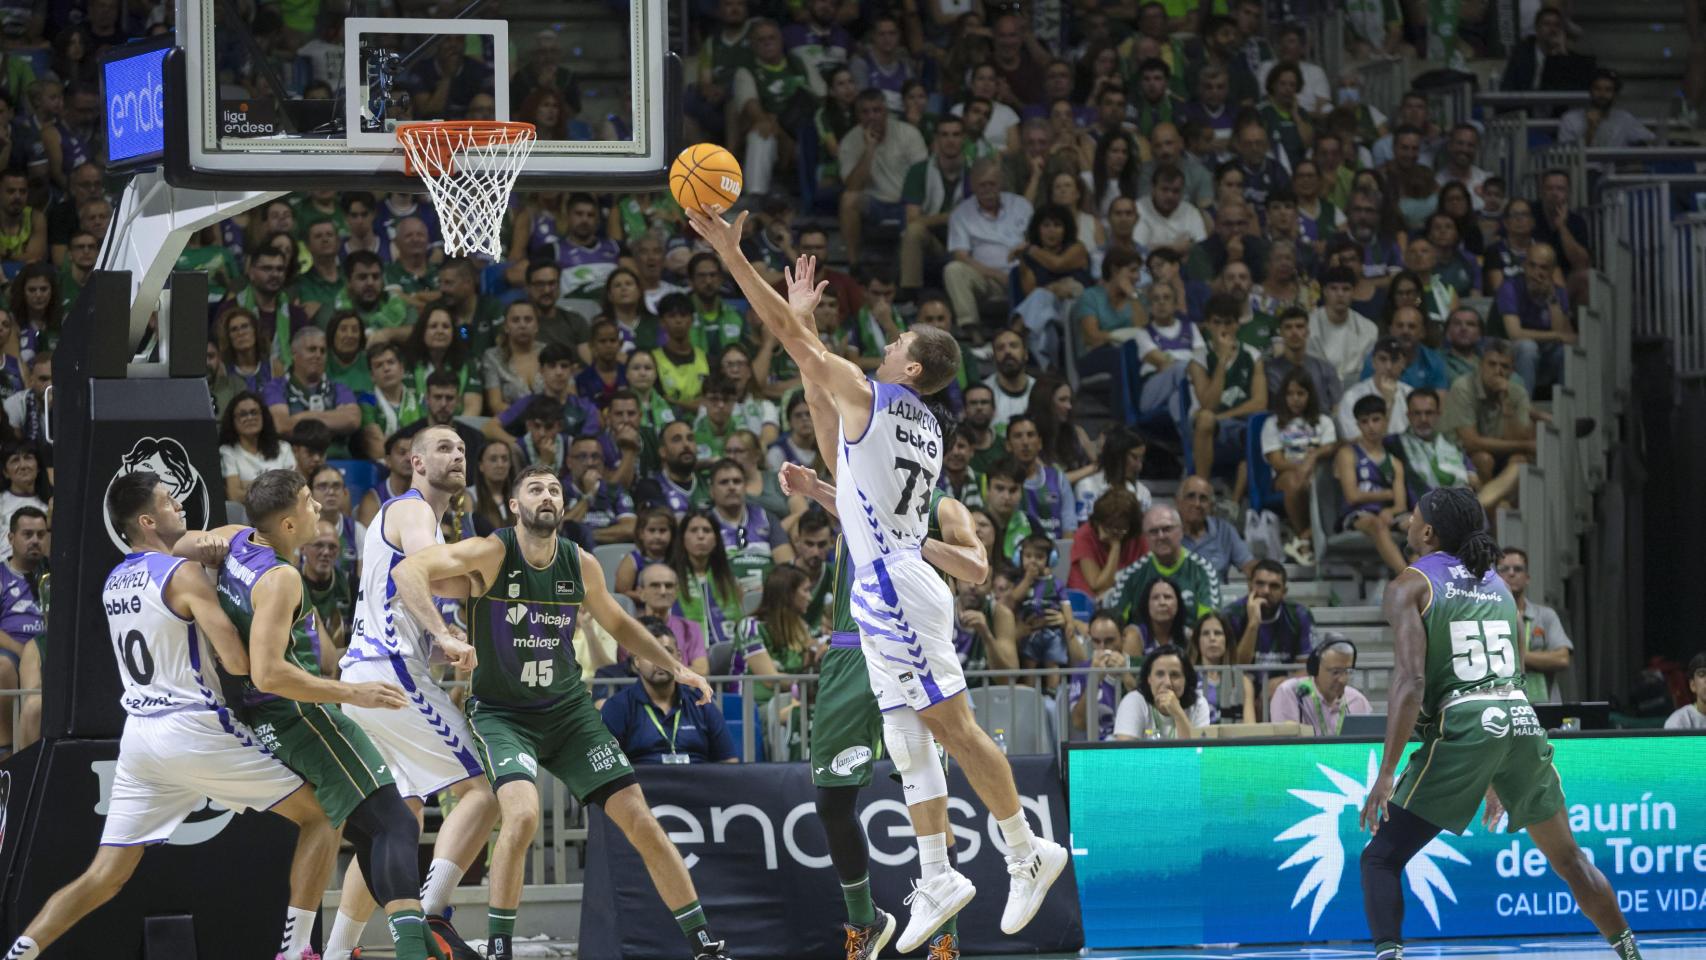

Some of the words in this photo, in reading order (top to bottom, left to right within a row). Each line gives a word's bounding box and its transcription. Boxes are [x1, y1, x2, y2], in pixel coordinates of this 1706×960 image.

[223, 110, 247, 123] liga
[224, 121, 273, 133] endesa
[529, 611, 572, 628] Unicaja
[1449, 619, 1516, 682] 55
[520, 659, 554, 688] 45
[591, 755, 617, 773] laga
[1495, 839, 1548, 878] de
[1617, 889, 1649, 913] DE
